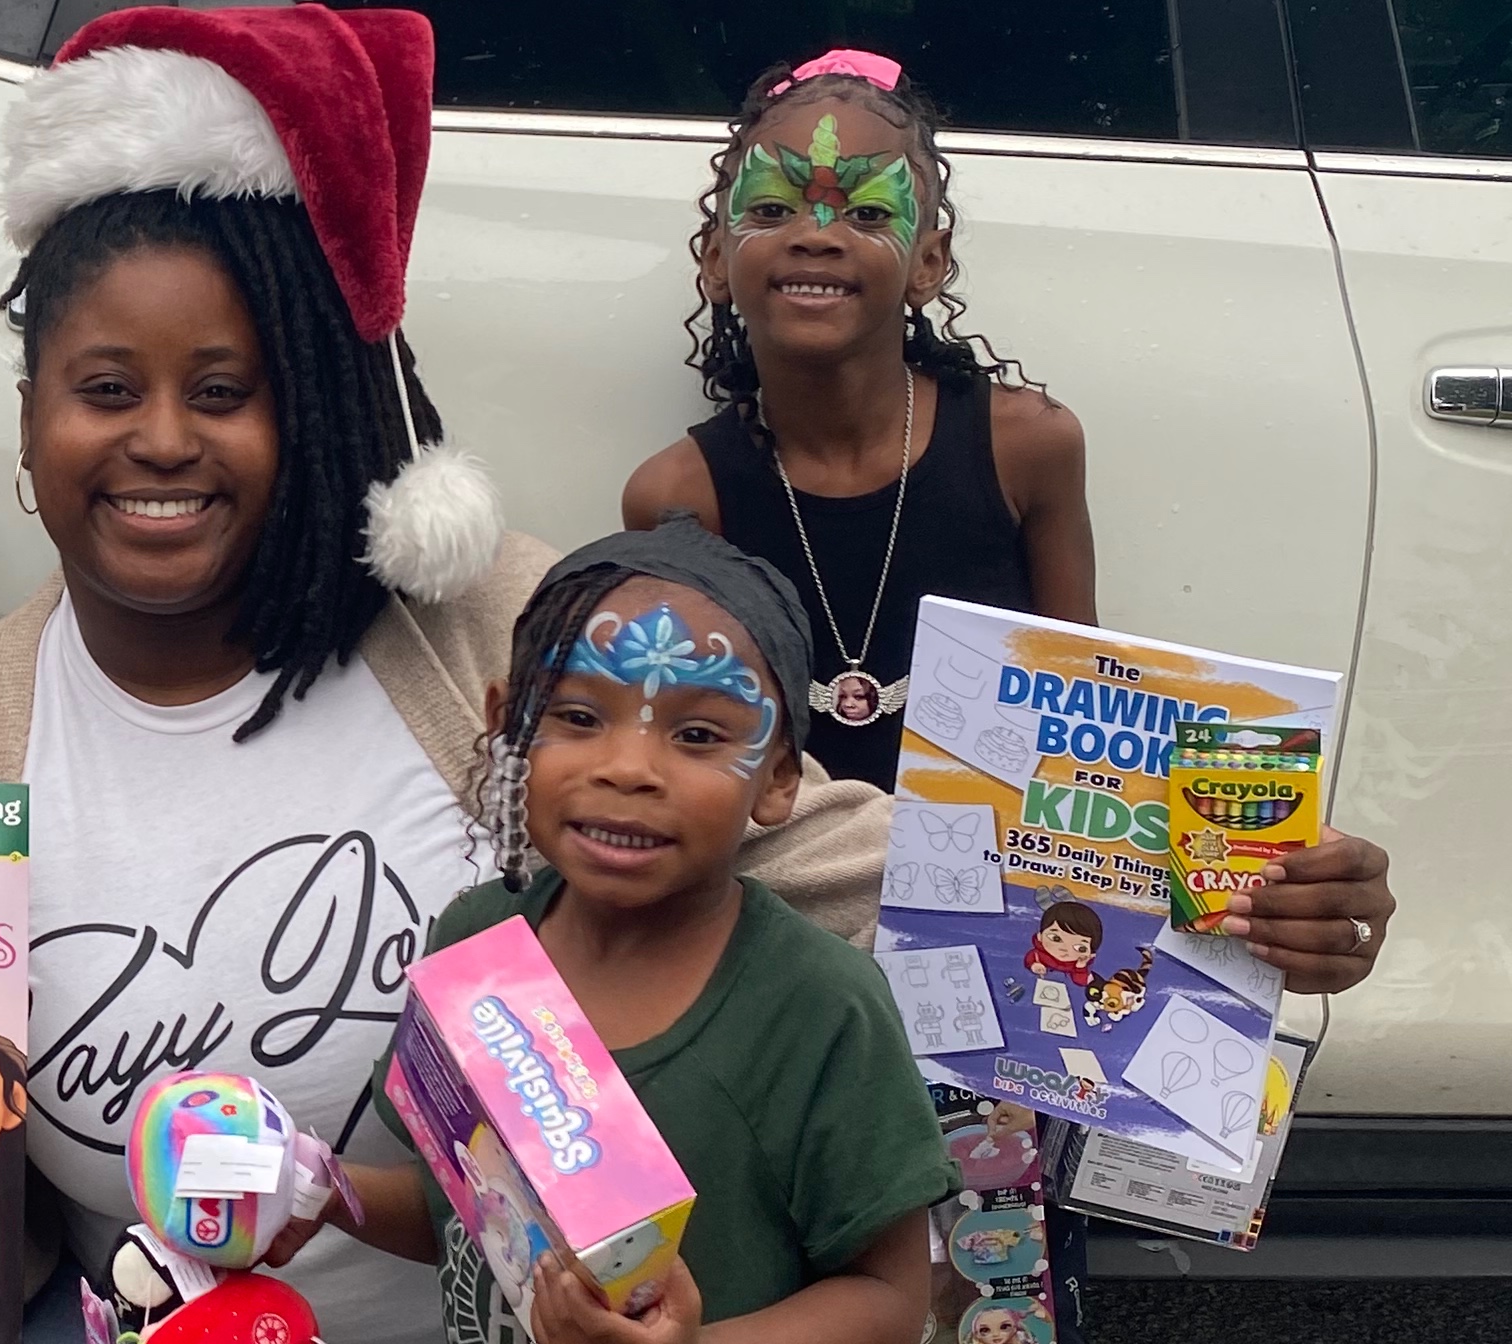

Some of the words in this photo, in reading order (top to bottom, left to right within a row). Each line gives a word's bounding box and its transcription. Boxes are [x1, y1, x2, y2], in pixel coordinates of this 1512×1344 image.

[1095, 655, 1140, 681] The
[1185, 729, 1211, 743] 24
[1074, 770, 1123, 790] FOR
[1191, 778, 1294, 801] Crayola
[1023, 779, 1170, 853] KIDS
[1006, 829, 1052, 854] 365
[1057, 843, 1106, 869] Daily
[1112, 854, 1171, 881] Things
[983, 849, 1002, 865] to
[1008, 854, 1065, 878] Draw:
[1071, 866, 1113, 889] Step
[1119, 876, 1145, 897] by
[1149, 883, 1171, 900] St
[1187, 870, 1266, 892] CRAYO
[472, 996, 598, 1172] Squishville
